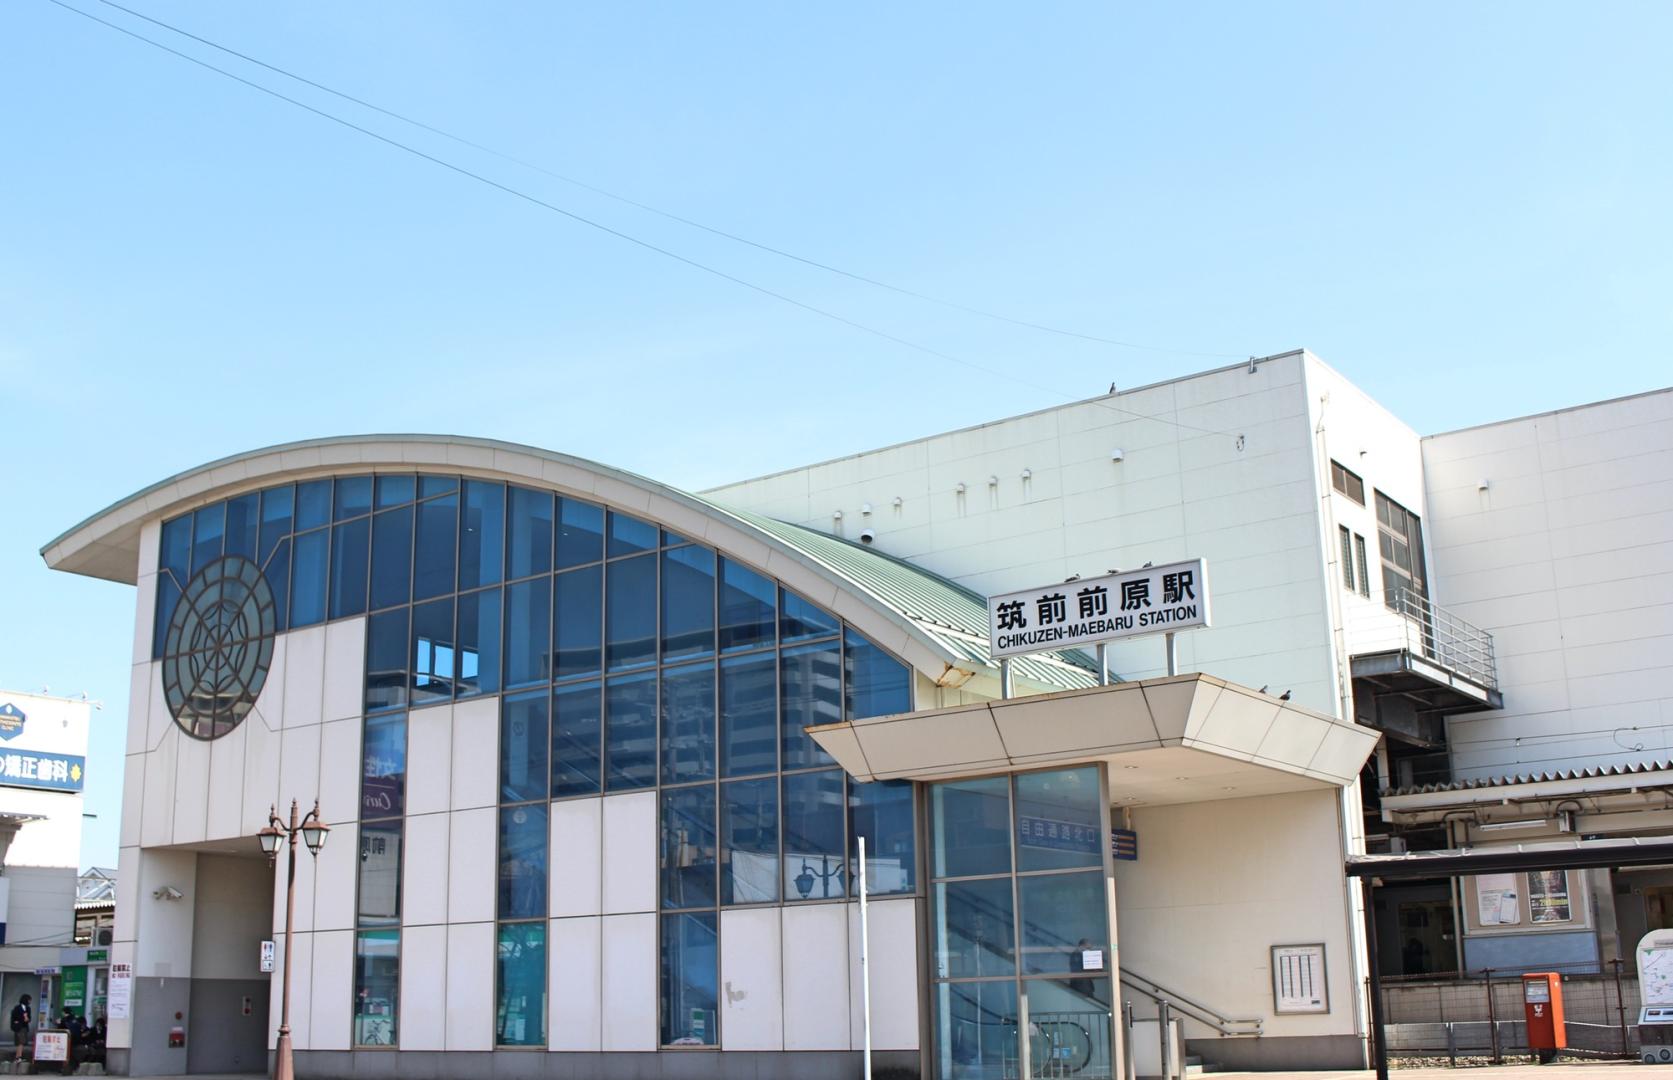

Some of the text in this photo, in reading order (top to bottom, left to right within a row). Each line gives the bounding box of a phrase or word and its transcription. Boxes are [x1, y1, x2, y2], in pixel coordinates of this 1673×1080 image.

[996, 570, 1196, 631] 筑前前原駅
[997, 605, 1197, 649] CHIKUZEN-MAEBARU STATION
